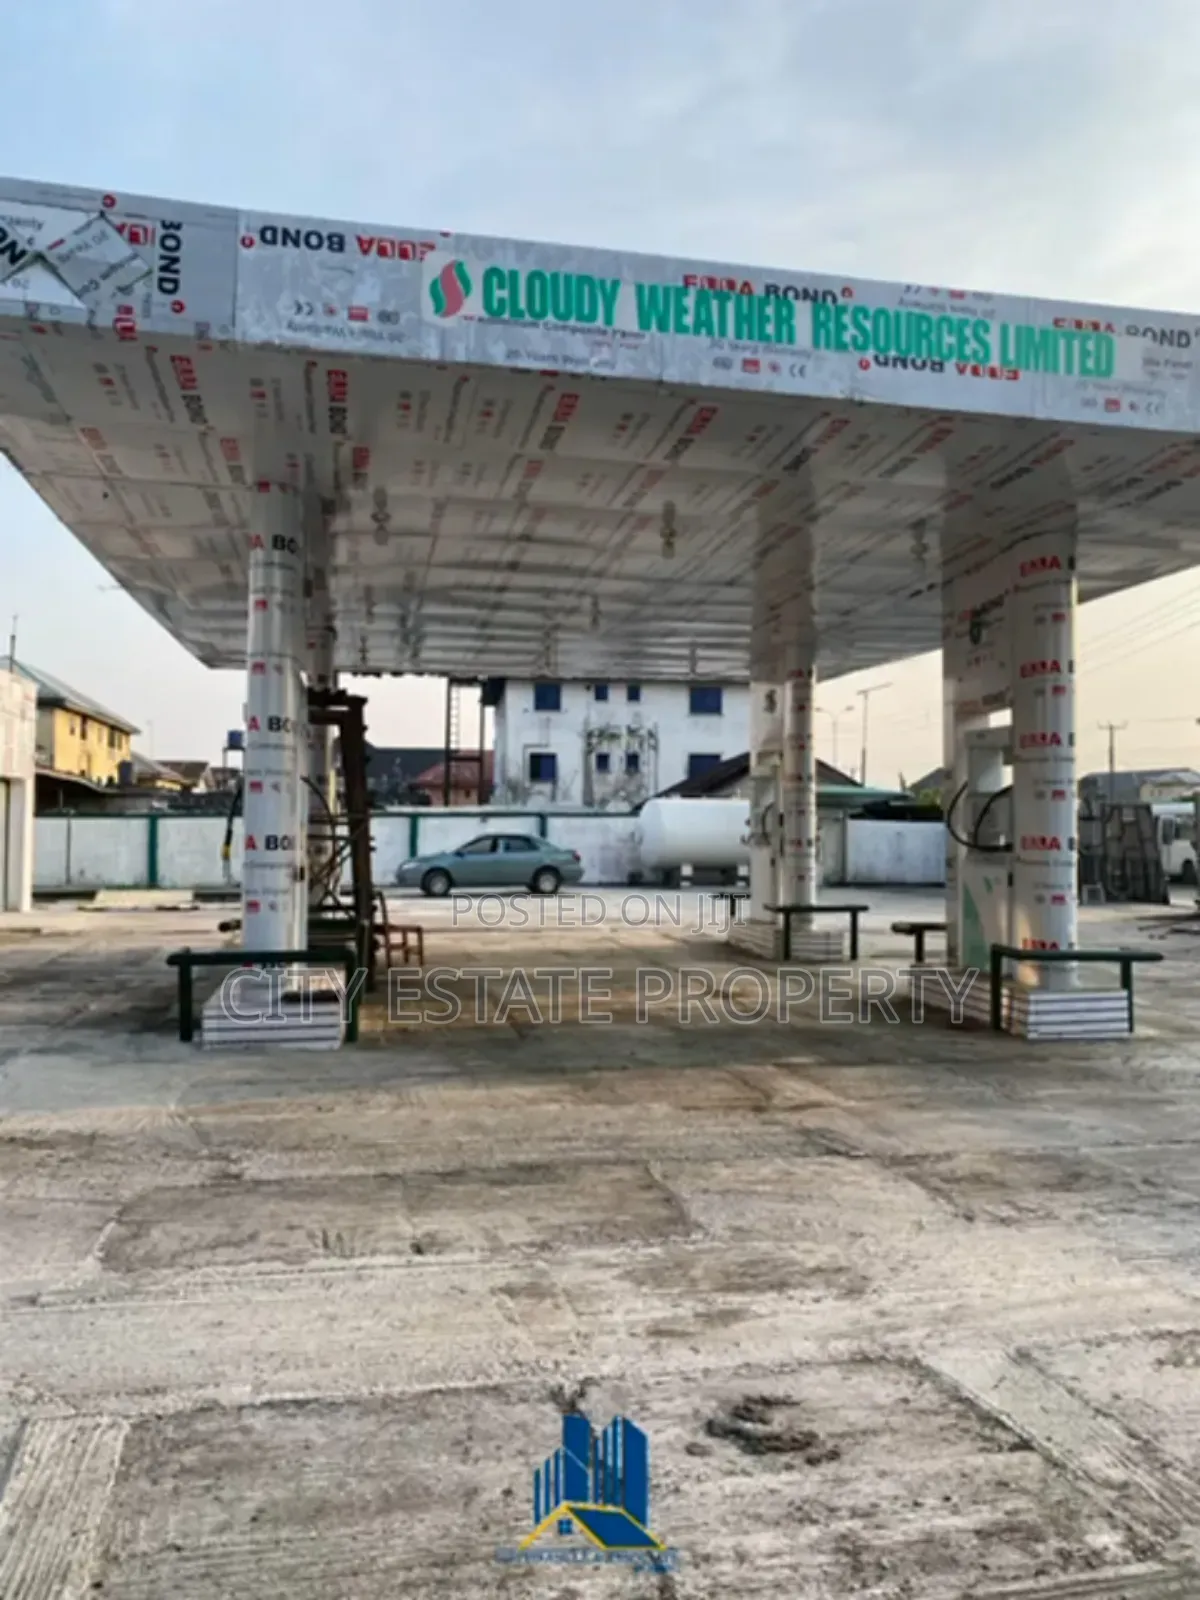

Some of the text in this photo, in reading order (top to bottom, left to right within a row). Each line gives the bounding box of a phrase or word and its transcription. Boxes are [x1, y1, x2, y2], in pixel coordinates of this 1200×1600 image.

[259, 225, 346, 253] BOND
[482, 265, 1116, 378] CLOUDY WEATHER RESOURCES LIMITED
